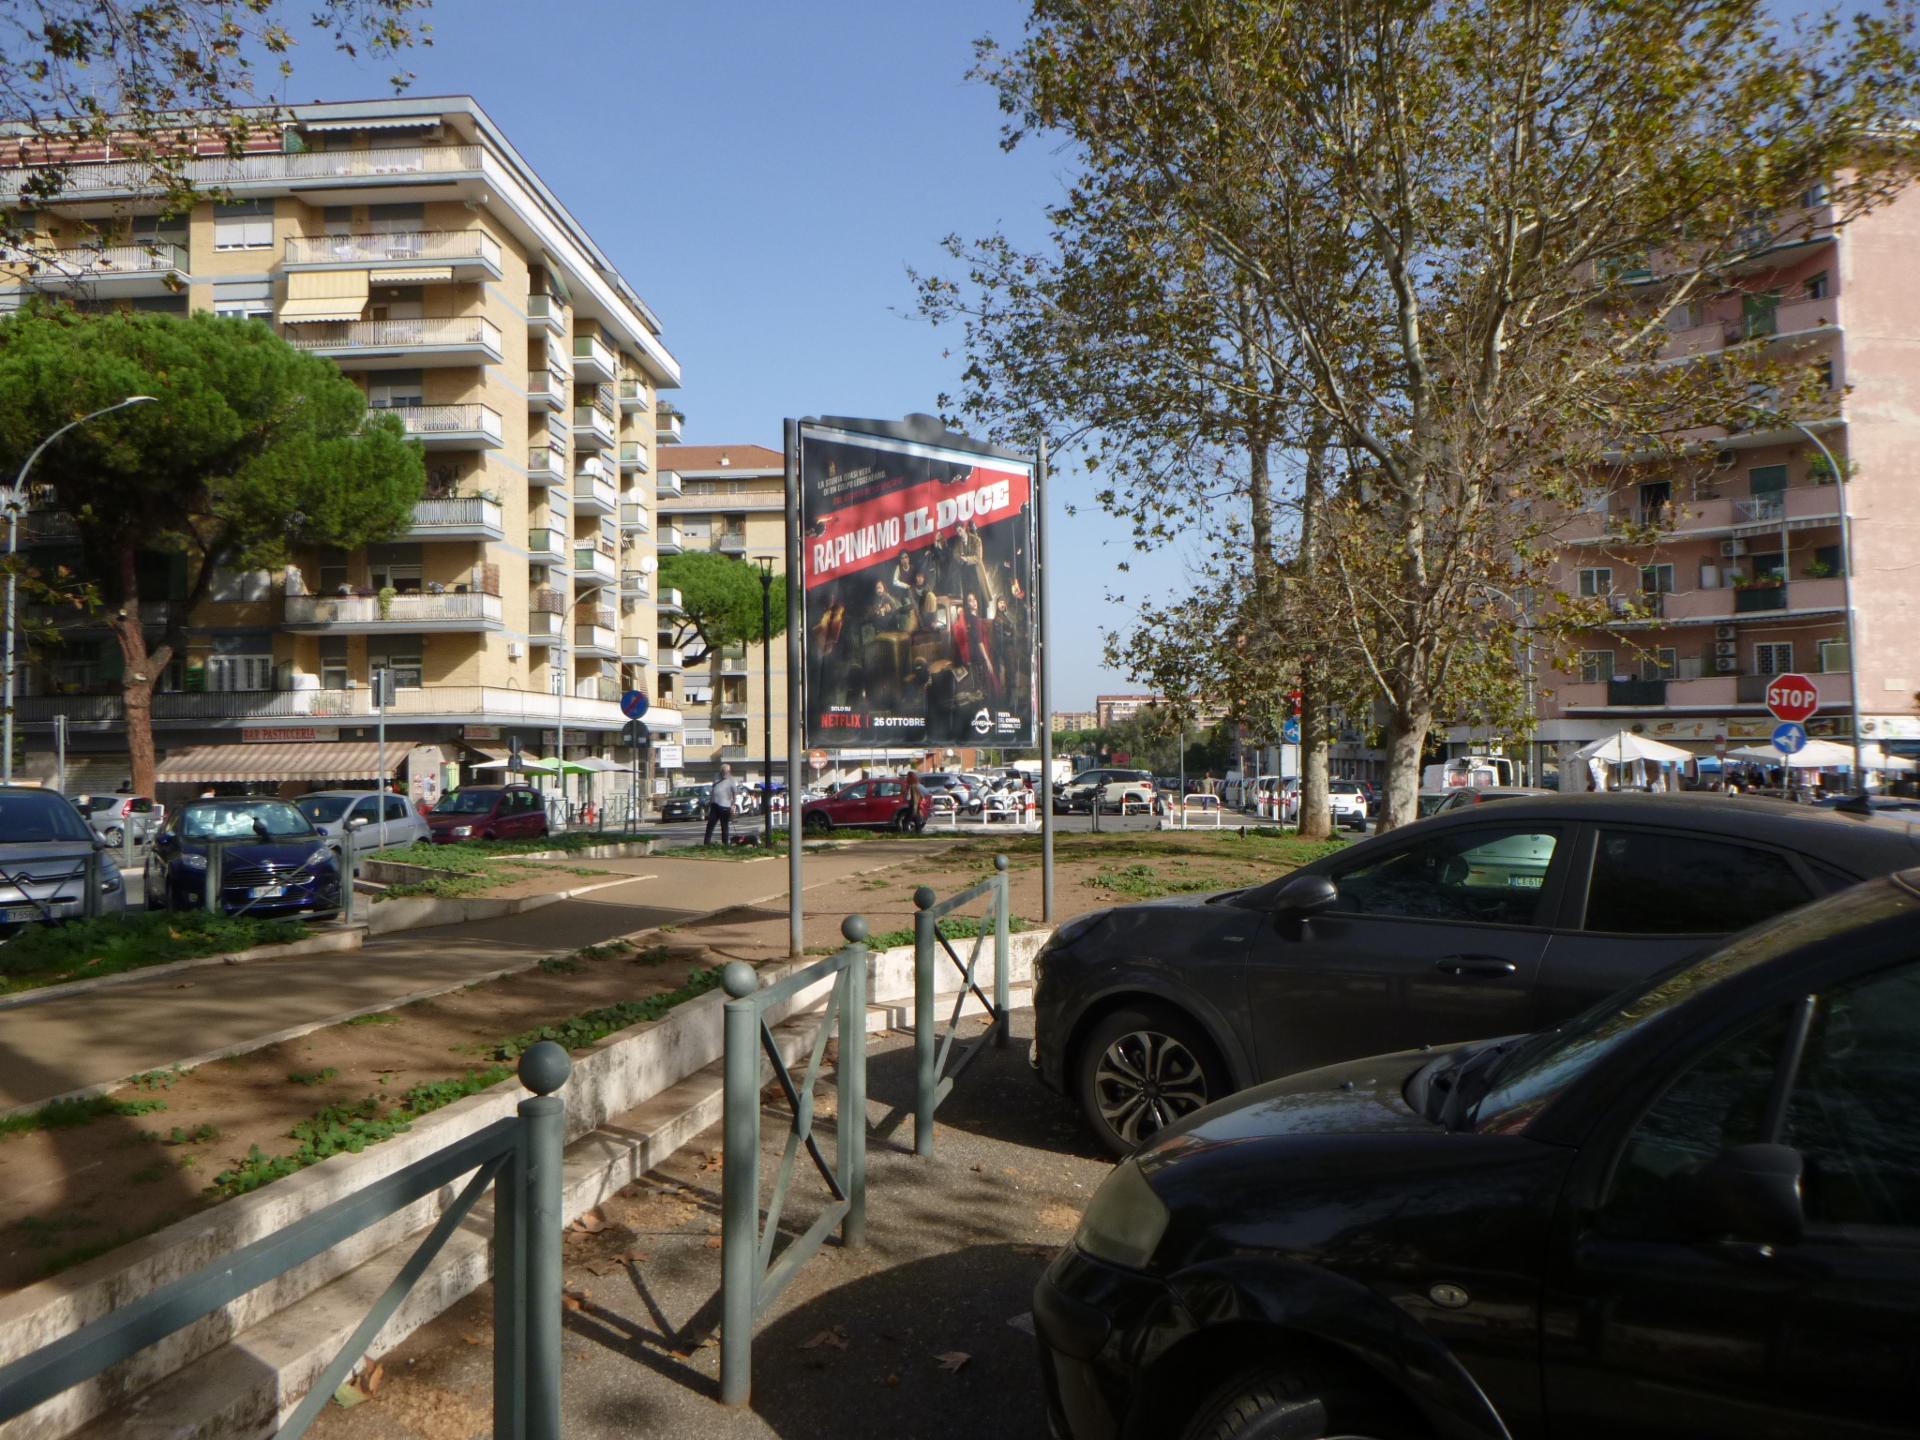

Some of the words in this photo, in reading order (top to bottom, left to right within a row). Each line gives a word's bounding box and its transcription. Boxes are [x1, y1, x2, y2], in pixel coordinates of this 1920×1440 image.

[817, 480, 825, 489] LA
[813, 516, 900, 575] RAPINIAMO
[904, 506, 935, 542] IL
[936, 480, 1010, 530] DUCE
[1770, 688, 1815, 708] STOP
[821, 713, 861, 728] NETFLIX
[874, 717, 884, 727] 26
[885, 717, 926, 727] OTTOBRE
[243, 728, 260, 740] BAR
[263, 727, 316, 740] PASTICCERIA
